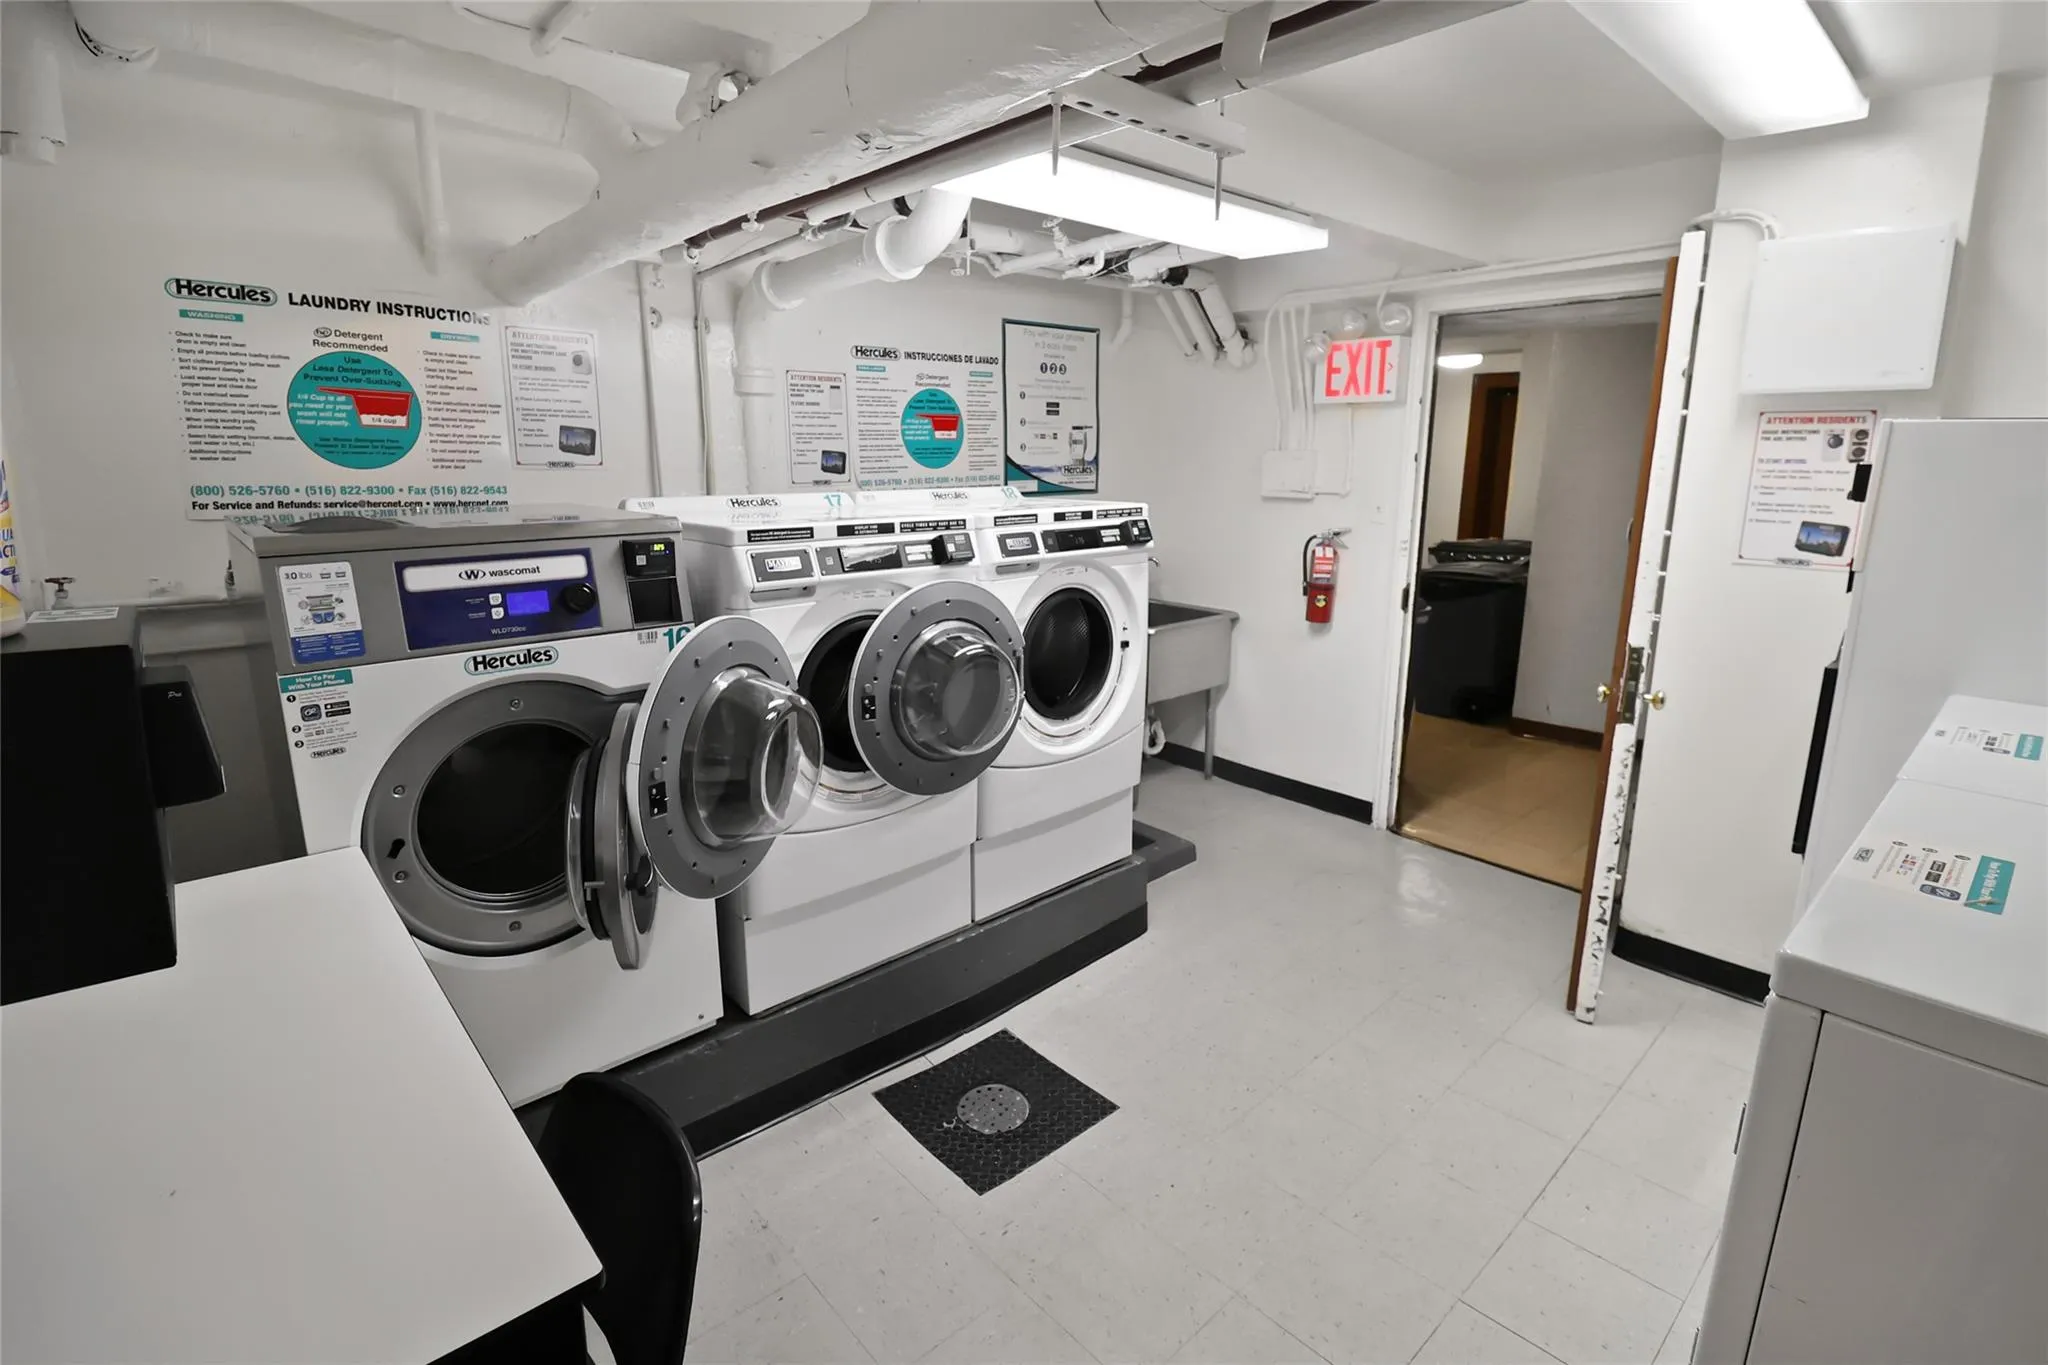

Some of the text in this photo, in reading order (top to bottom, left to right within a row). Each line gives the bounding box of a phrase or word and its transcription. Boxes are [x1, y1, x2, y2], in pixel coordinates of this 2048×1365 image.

[174, 278, 272, 303] Hercules
[287, 292, 491, 326] LAUNDRY INSTRUCTIONS
[334, 329, 384, 342] Detergent
[312, 339, 389, 353] Recommended
[854, 345, 898, 359] Hercules
[343, 356, 362, 365] Use
[903, 351, 999, 366] INSTRUCCIONES DE LAVADO
[312, 363, 394, 377] Less Detergent To
[1325, 340, 1392, 397] EXIT
[303, 373, 402, 388] Prevent Over-Sudsing
[1766, 415, 1868, 424] ATTENTION RESIDENTS
[1063, 465, 1093, 474] Hercules
[190, 485, 508, 498] (800) 526-5760 (516) 822-9300 Fax (516) 822-9543
[932, 487, 1018, 501] Hercules 18
[191, 499, 509, 510] For Service and Refunds: service@hercnet.com www.hercnet.com
[730, 494, 842, 508] Hercules 17
[464, 565, 541, 580] W wascomat
[472, 648, 554, 672] Hercules
[287, 679, 346, 691] With Your Phone
[312, 747, 345, 758] Hercules
